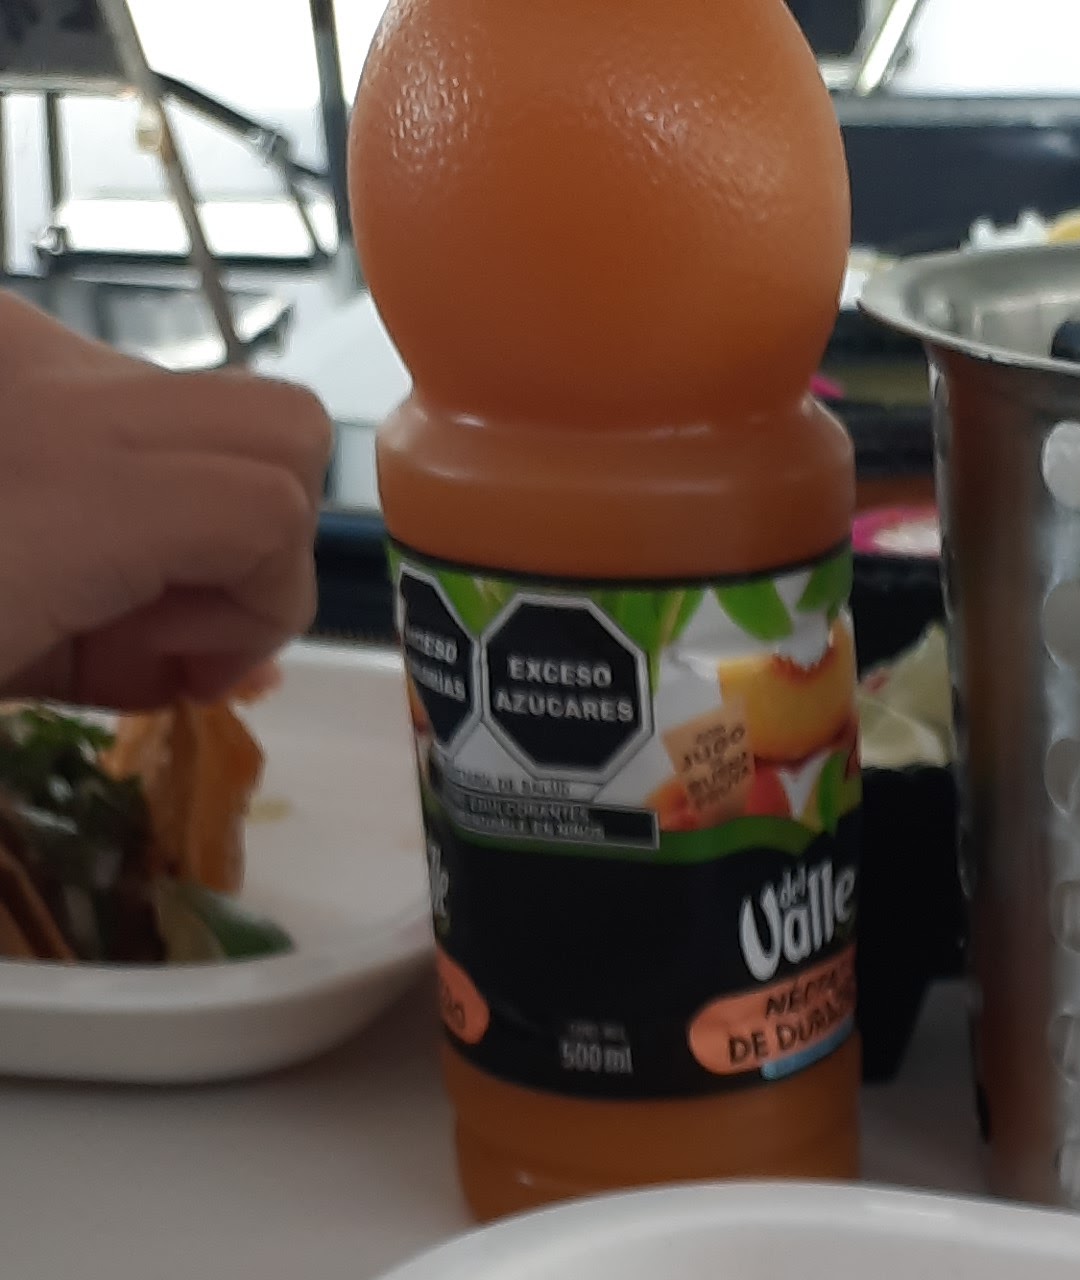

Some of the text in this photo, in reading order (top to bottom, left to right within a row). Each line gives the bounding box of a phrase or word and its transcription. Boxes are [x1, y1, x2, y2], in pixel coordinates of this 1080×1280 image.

[507, 654, 613, 688] EXCESO
[496, 686, 634, 723] AZUCARES
[739, 857, 856, 982] Valle
[729, 1032, 768, 1065] DE
